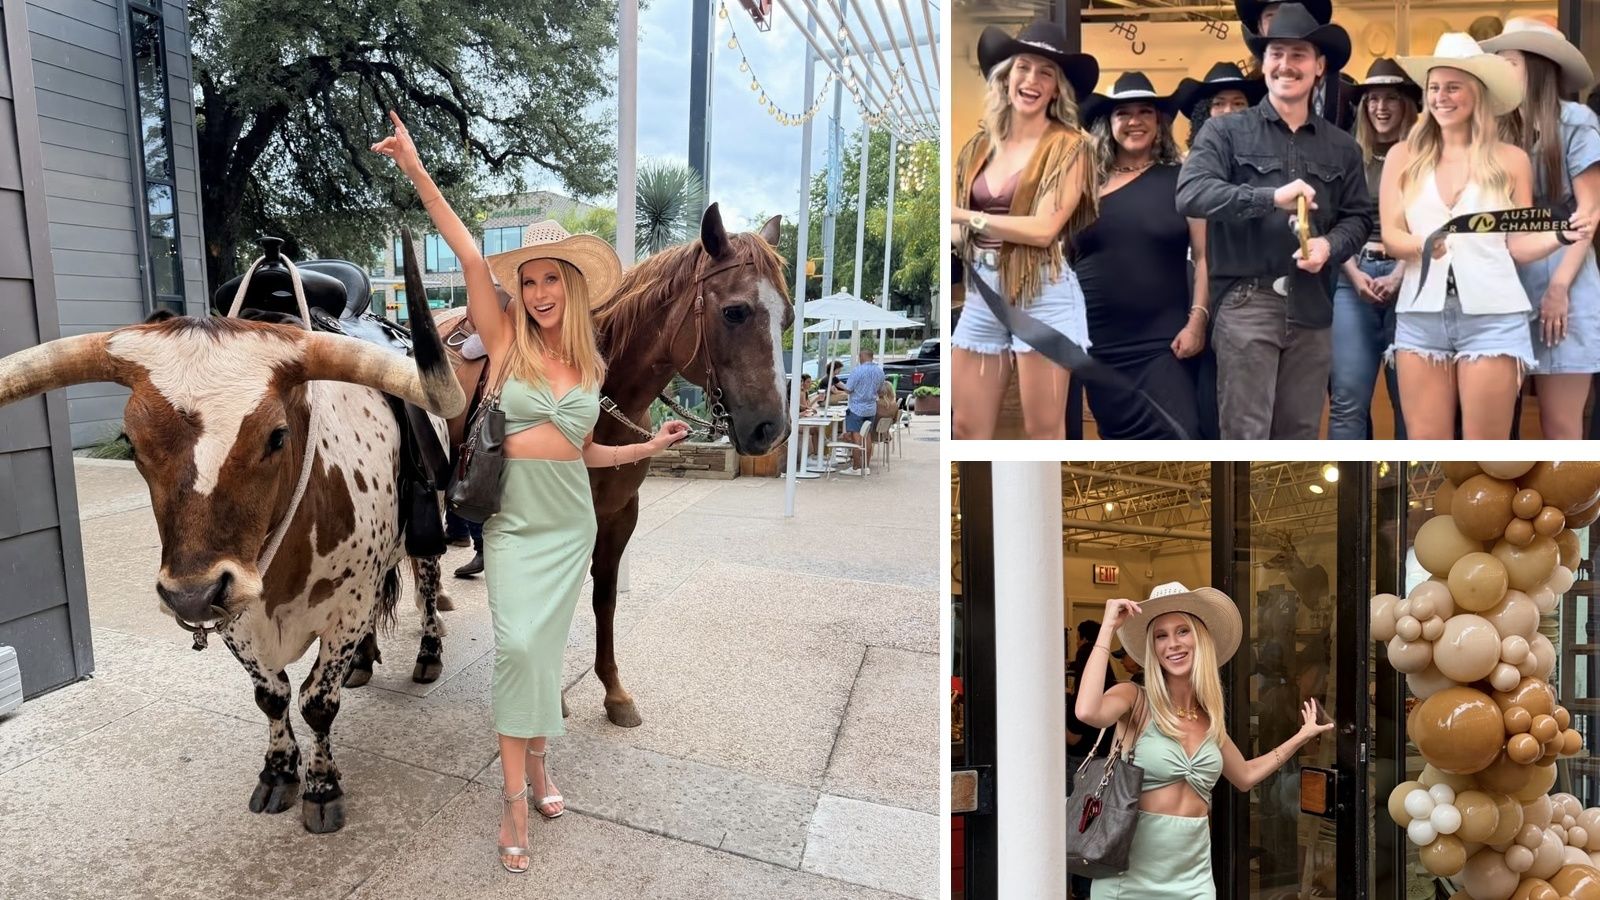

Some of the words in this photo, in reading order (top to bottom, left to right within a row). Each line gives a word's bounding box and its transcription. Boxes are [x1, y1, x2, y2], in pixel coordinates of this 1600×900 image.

[1501, 208, 1552, 220] AUSTIN
[1500, 220, 1568, 231] CHAMBER
[1099, 566, 1117, 582] EXIT
